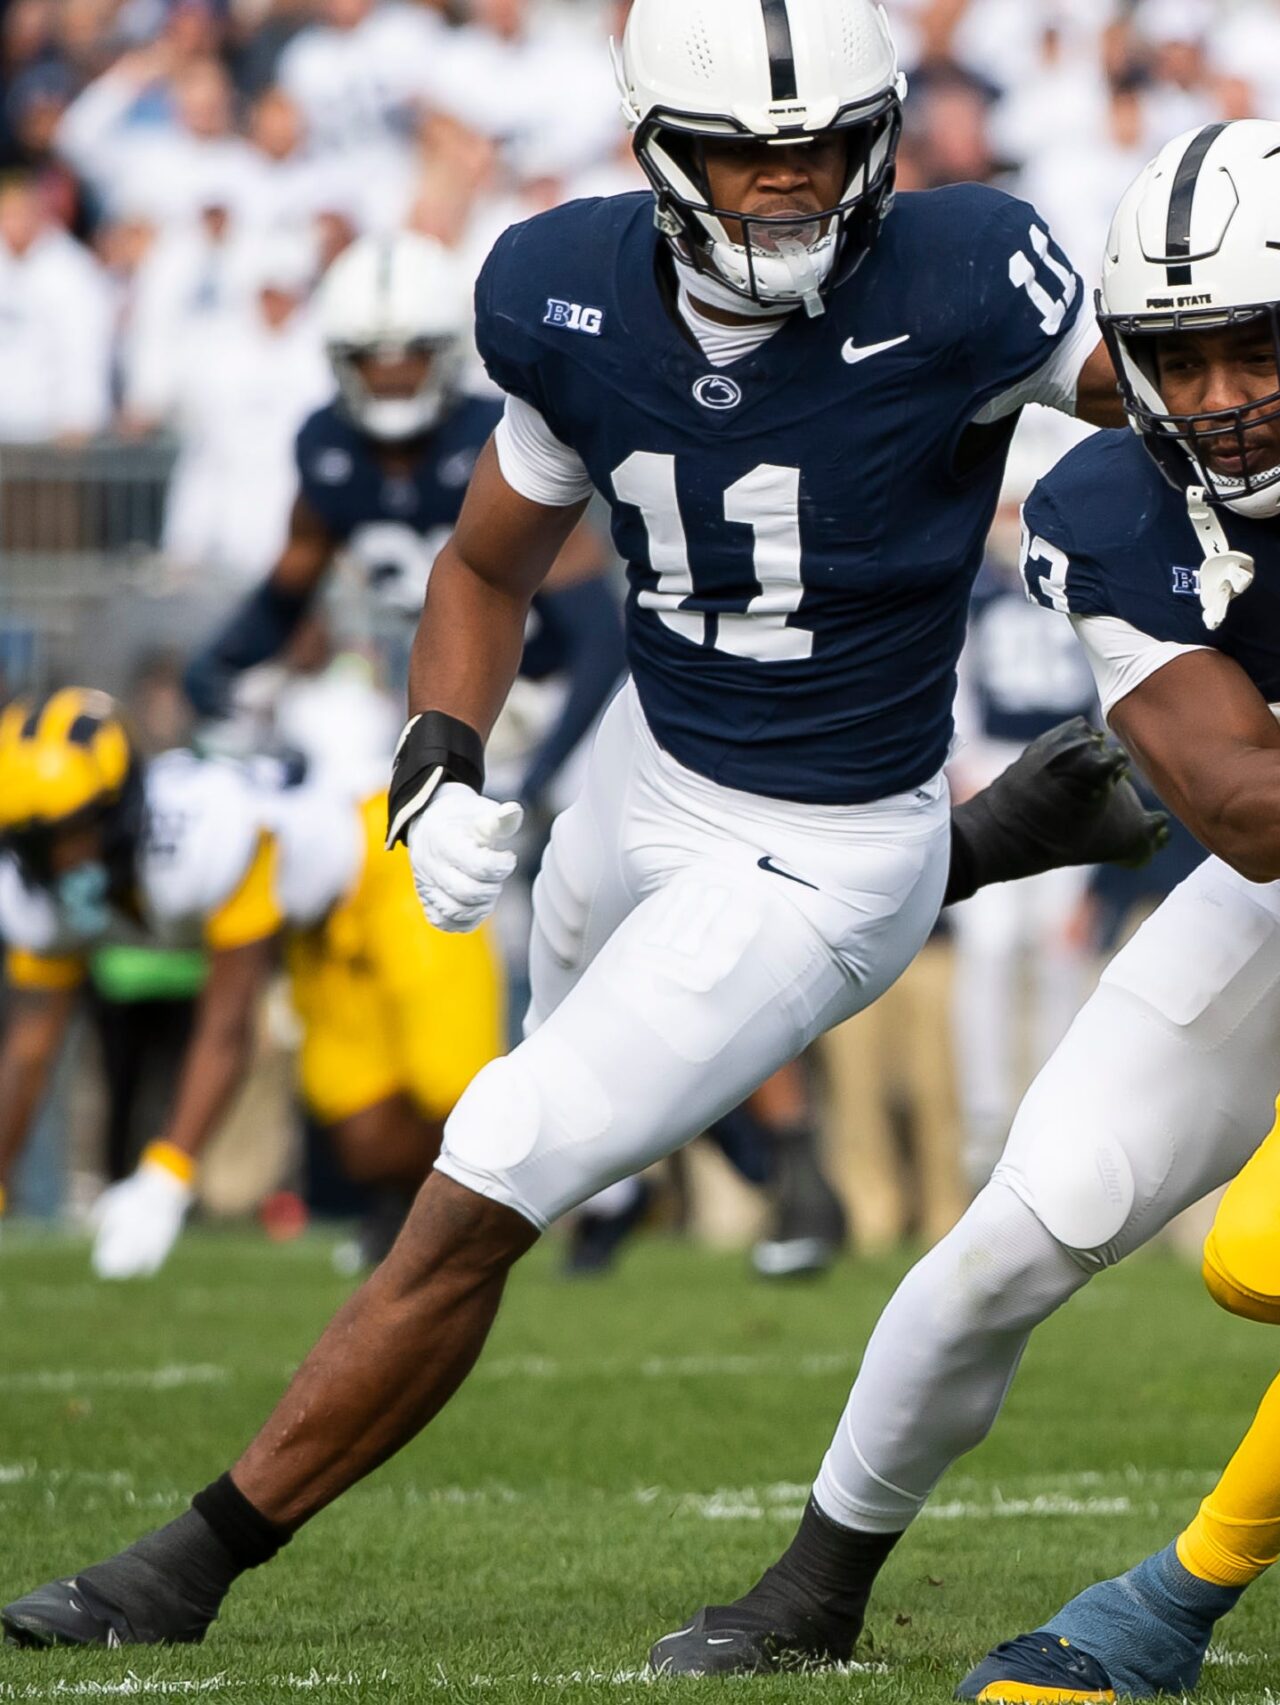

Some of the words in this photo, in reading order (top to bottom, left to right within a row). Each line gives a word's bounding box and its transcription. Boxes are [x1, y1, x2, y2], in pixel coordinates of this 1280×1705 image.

[1008, 223, 1077, 336] 11
[1176, 293, 1212, 307] STATE
[610, 450, 814, 662] 11
